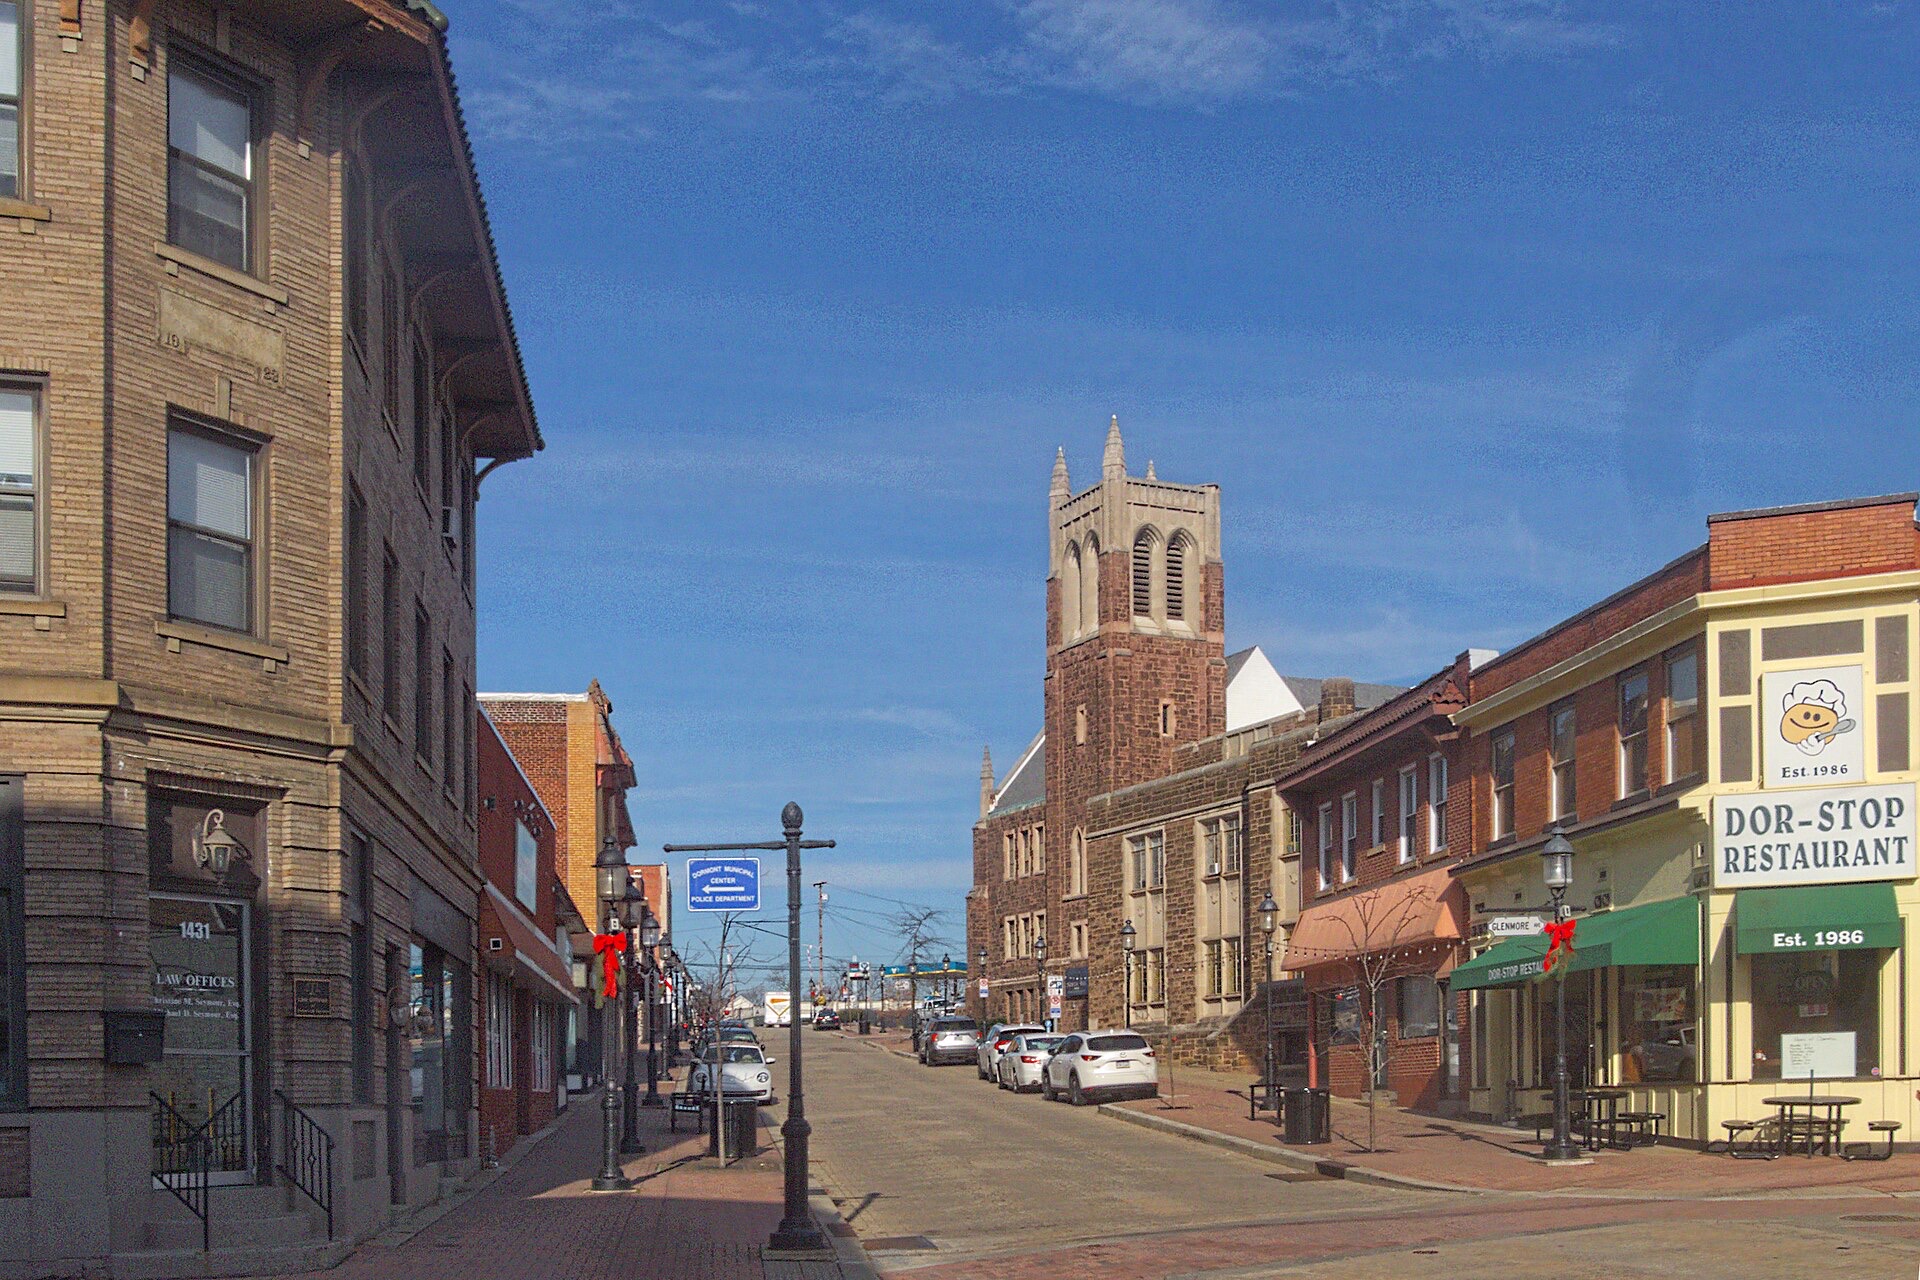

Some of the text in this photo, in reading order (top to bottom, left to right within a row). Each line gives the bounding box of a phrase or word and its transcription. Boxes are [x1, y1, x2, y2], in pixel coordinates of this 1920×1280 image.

[1782, 764, 1848, 778] Est. 1986
[1725, 797, 1905, 837] DOR-STOP
[1723, 836, 1908, 874] RESTAURANT
[692, 866, 754, 879] DORMONT MUNICIPAL
[180, 921, 210, 939] 1431
[1492, 921, 1529, 931] GLENMORE
[1773, 930, 1864, 947] Est. 1986
[1488, 962, 1544, 980] DOR-STOP RESTAU
[157, 974, 235, 988] LAW OFFICES
